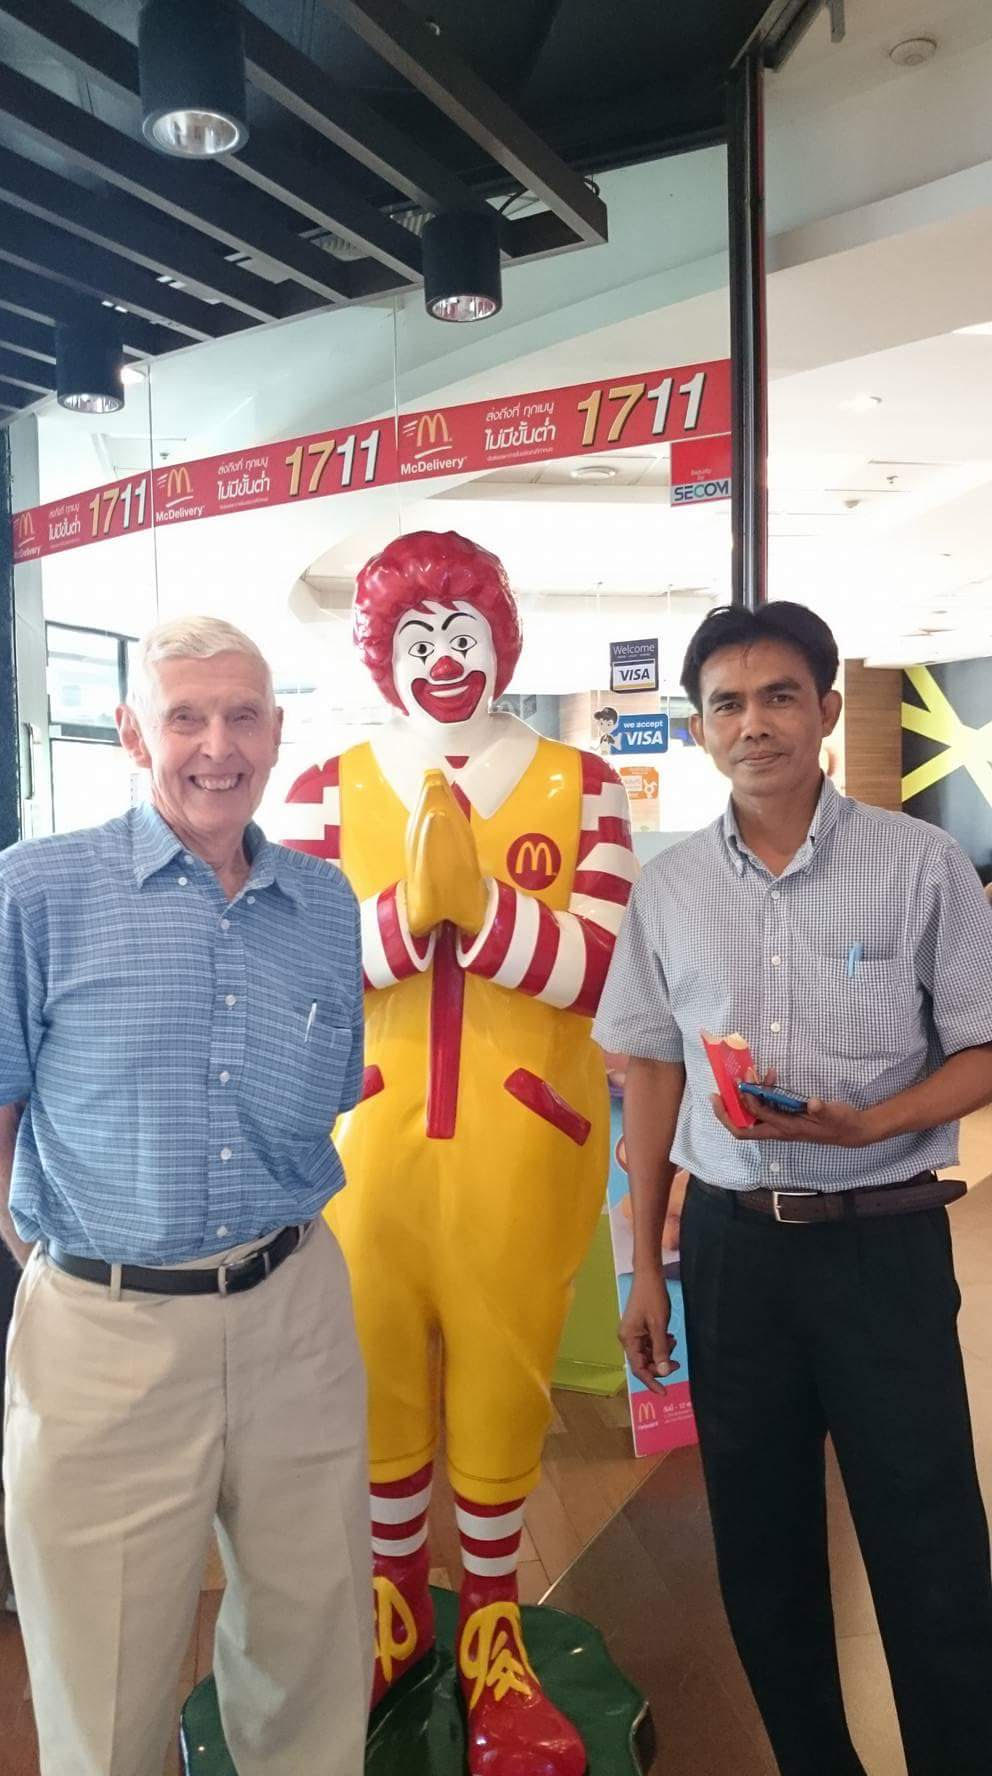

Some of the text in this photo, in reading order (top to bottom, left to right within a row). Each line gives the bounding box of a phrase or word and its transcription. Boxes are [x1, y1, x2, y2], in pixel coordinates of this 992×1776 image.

[523, 402, 554, 418] ทุกเมนู
[577, 372, 706, 447] 1711
[485, 416, 556, 451] ไม่มีขั้นต่ำ
[285, 429, 381, 497] 1711
[400, 456, 465, 476] McDelivery
[217, 470, 270, 501] ไม่มีขั้นต่ำ
[674, 479, 729, 502] SECOM
[89, 478, 147, 538] 1711
[155, 505, 203, 523] McDelivery
[613, 644, 655, 657] Welcome
[619, 668, 650, 681] VISA
[623, 719, 664, 730] we accept
[625, 731, 663, 746] VISA
